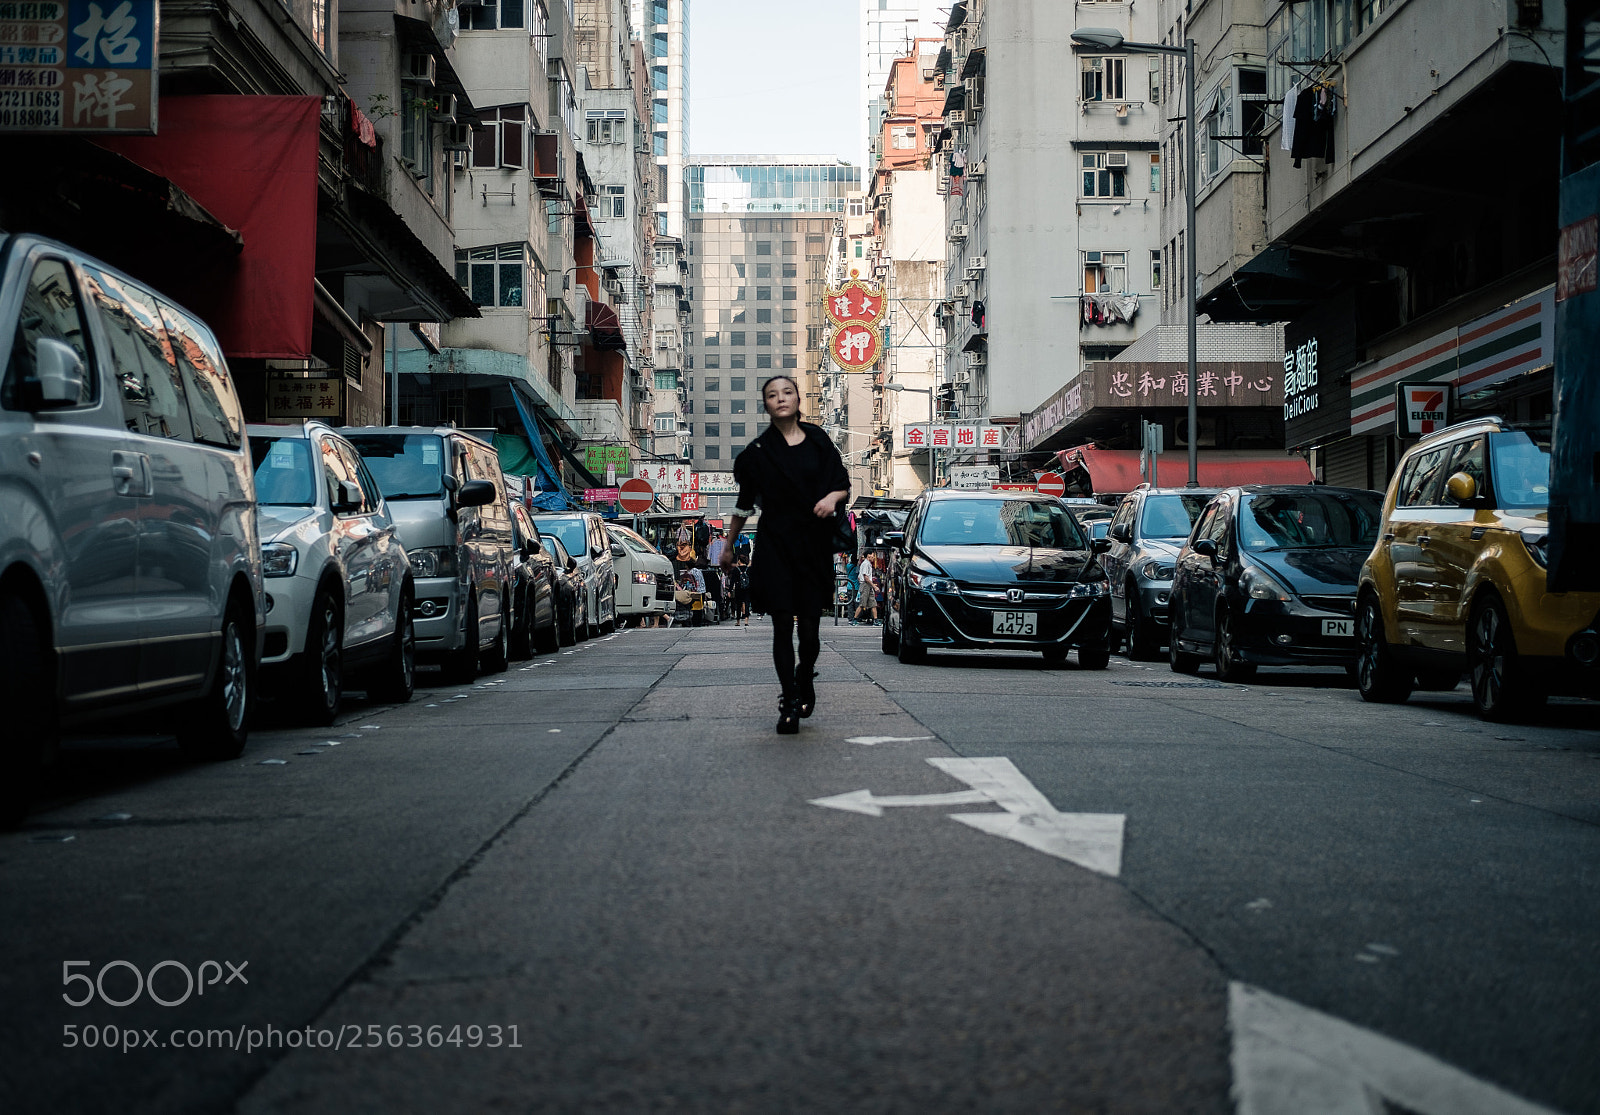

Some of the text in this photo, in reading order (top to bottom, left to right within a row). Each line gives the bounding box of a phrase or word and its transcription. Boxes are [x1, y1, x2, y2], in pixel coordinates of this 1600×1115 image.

[73, 1, 141, 128] 招牌
[839, 330, 870, 361] 押
[1109, 371, 1273, 397] 忠和商業中心
[274, 396, 335, 410] 陳福祥
[1412, 391, 1443, 433] 7
[639, 467, 685, 481] 通昇堂
[1006, 612, 1024, 623] PH
[996, 623, 1033, 634] 4473
[1327, 621, 1347, 634] PN
